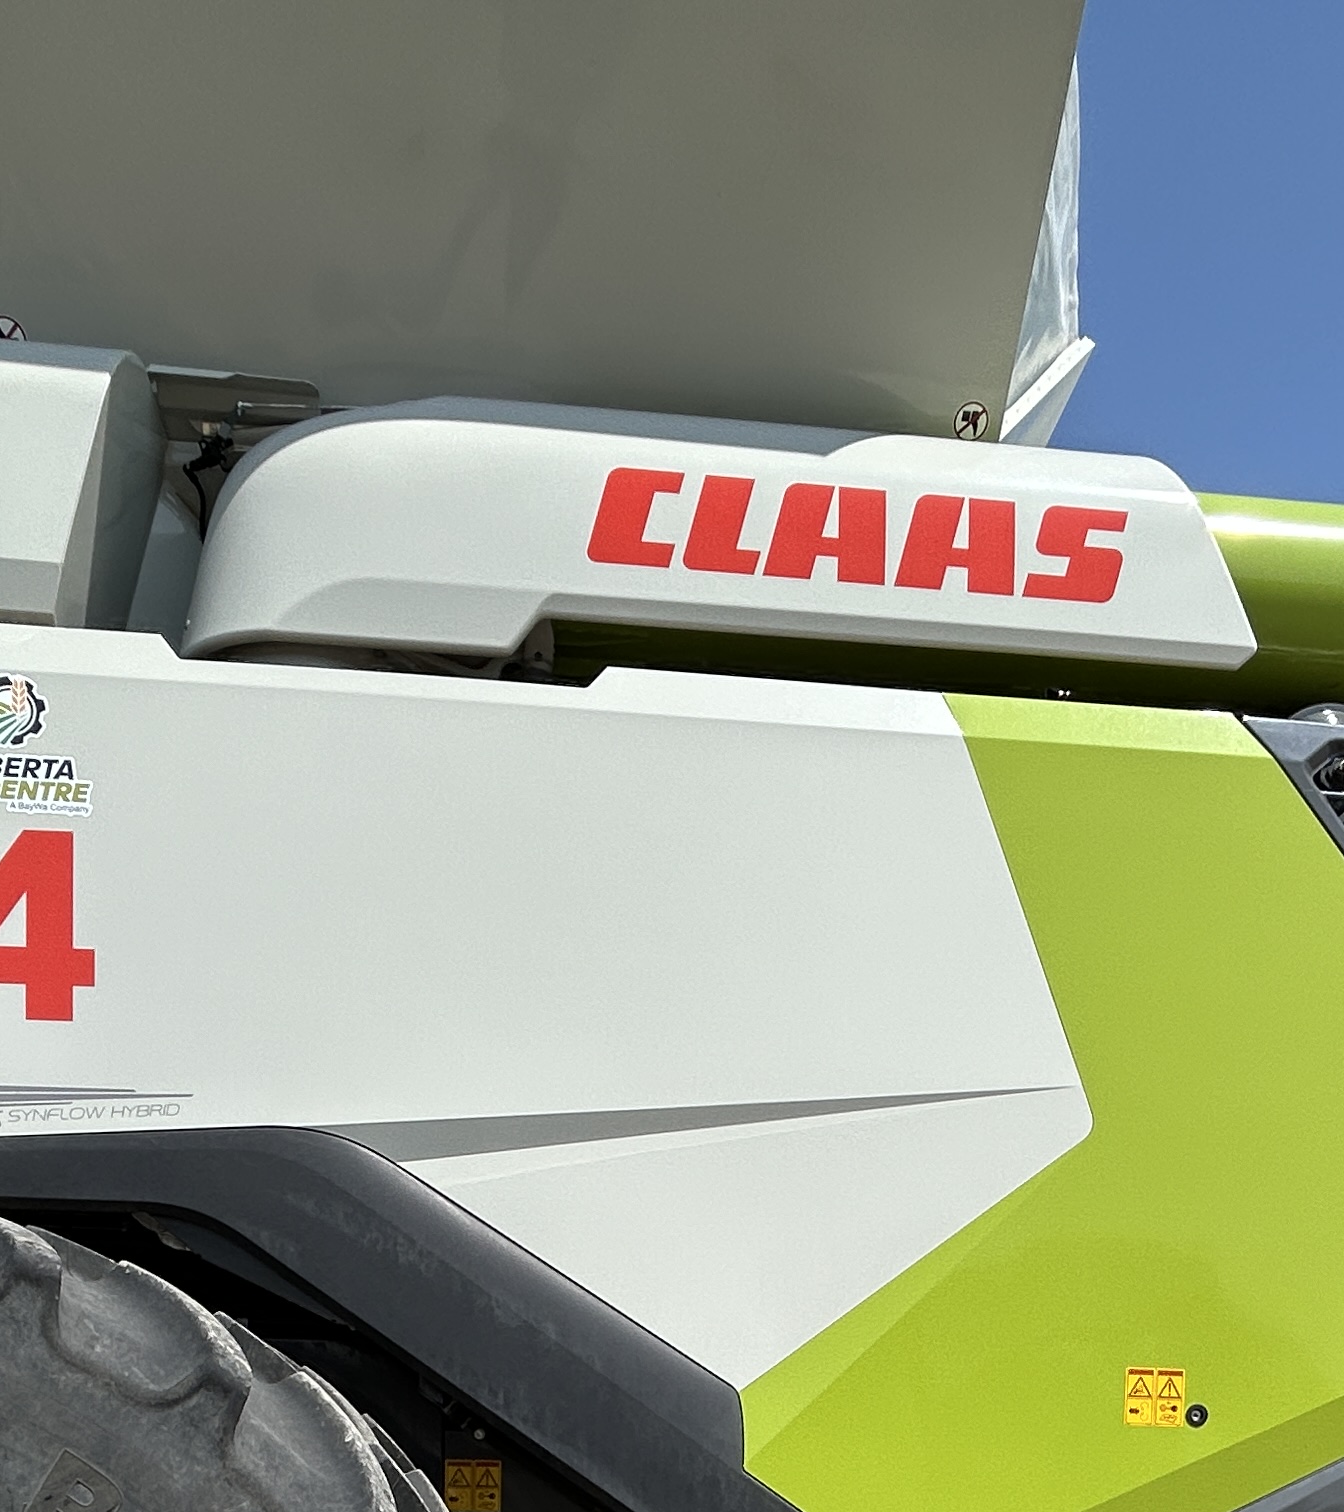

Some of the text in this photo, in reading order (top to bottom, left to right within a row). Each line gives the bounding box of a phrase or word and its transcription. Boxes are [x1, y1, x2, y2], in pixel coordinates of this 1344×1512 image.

[587, 467, 1128, 603] CLAAS
[50, 803, 90, 814] Company
[8, 1106, 106, 1122] SYNFLOW
[111, 1103, 181, 1119] HYBRID
